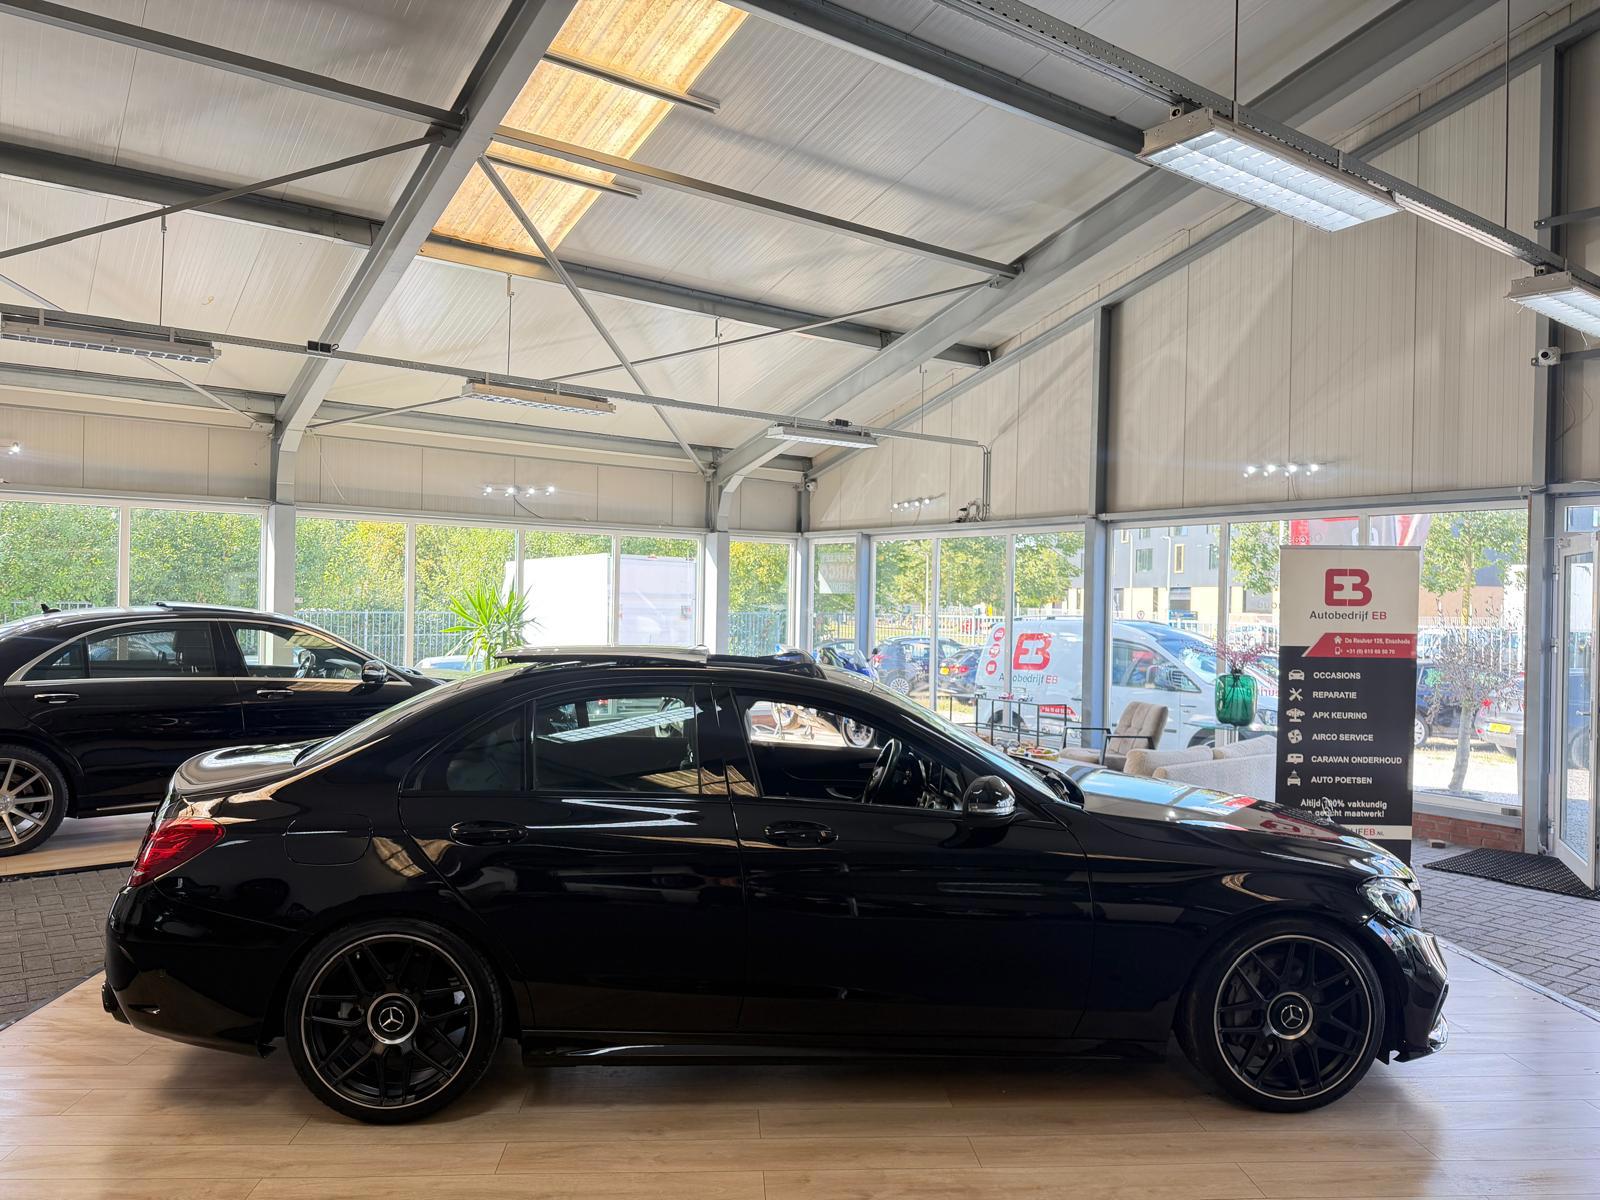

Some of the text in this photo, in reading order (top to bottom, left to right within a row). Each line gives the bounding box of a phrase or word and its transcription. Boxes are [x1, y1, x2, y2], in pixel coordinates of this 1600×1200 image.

[1324, 568, 1372, 606] EB
[1310, 610, 1388, 622] Autobedrijf EB
[998, 673, 1045, 687] Aobedrijf
[1313, 672, 1361, 680] OCCASIONS
[1312, 691, 1357, 699] REPARATIE
[1312, 711, 1368, 720] APK KEURING
[1312, 733, 1374, 742] AIRCO SERVICE
[1311, 756, 1402, 764] CARAVAN ONDERHOUD
[1311, 776, 1372, 784] AUTO POETSEN
[1300, 798, 1321, 809] Altijd
[1347, 799, 1388, 809] vakkundig
[1344, 809, 1384, 818] maatwerk!
